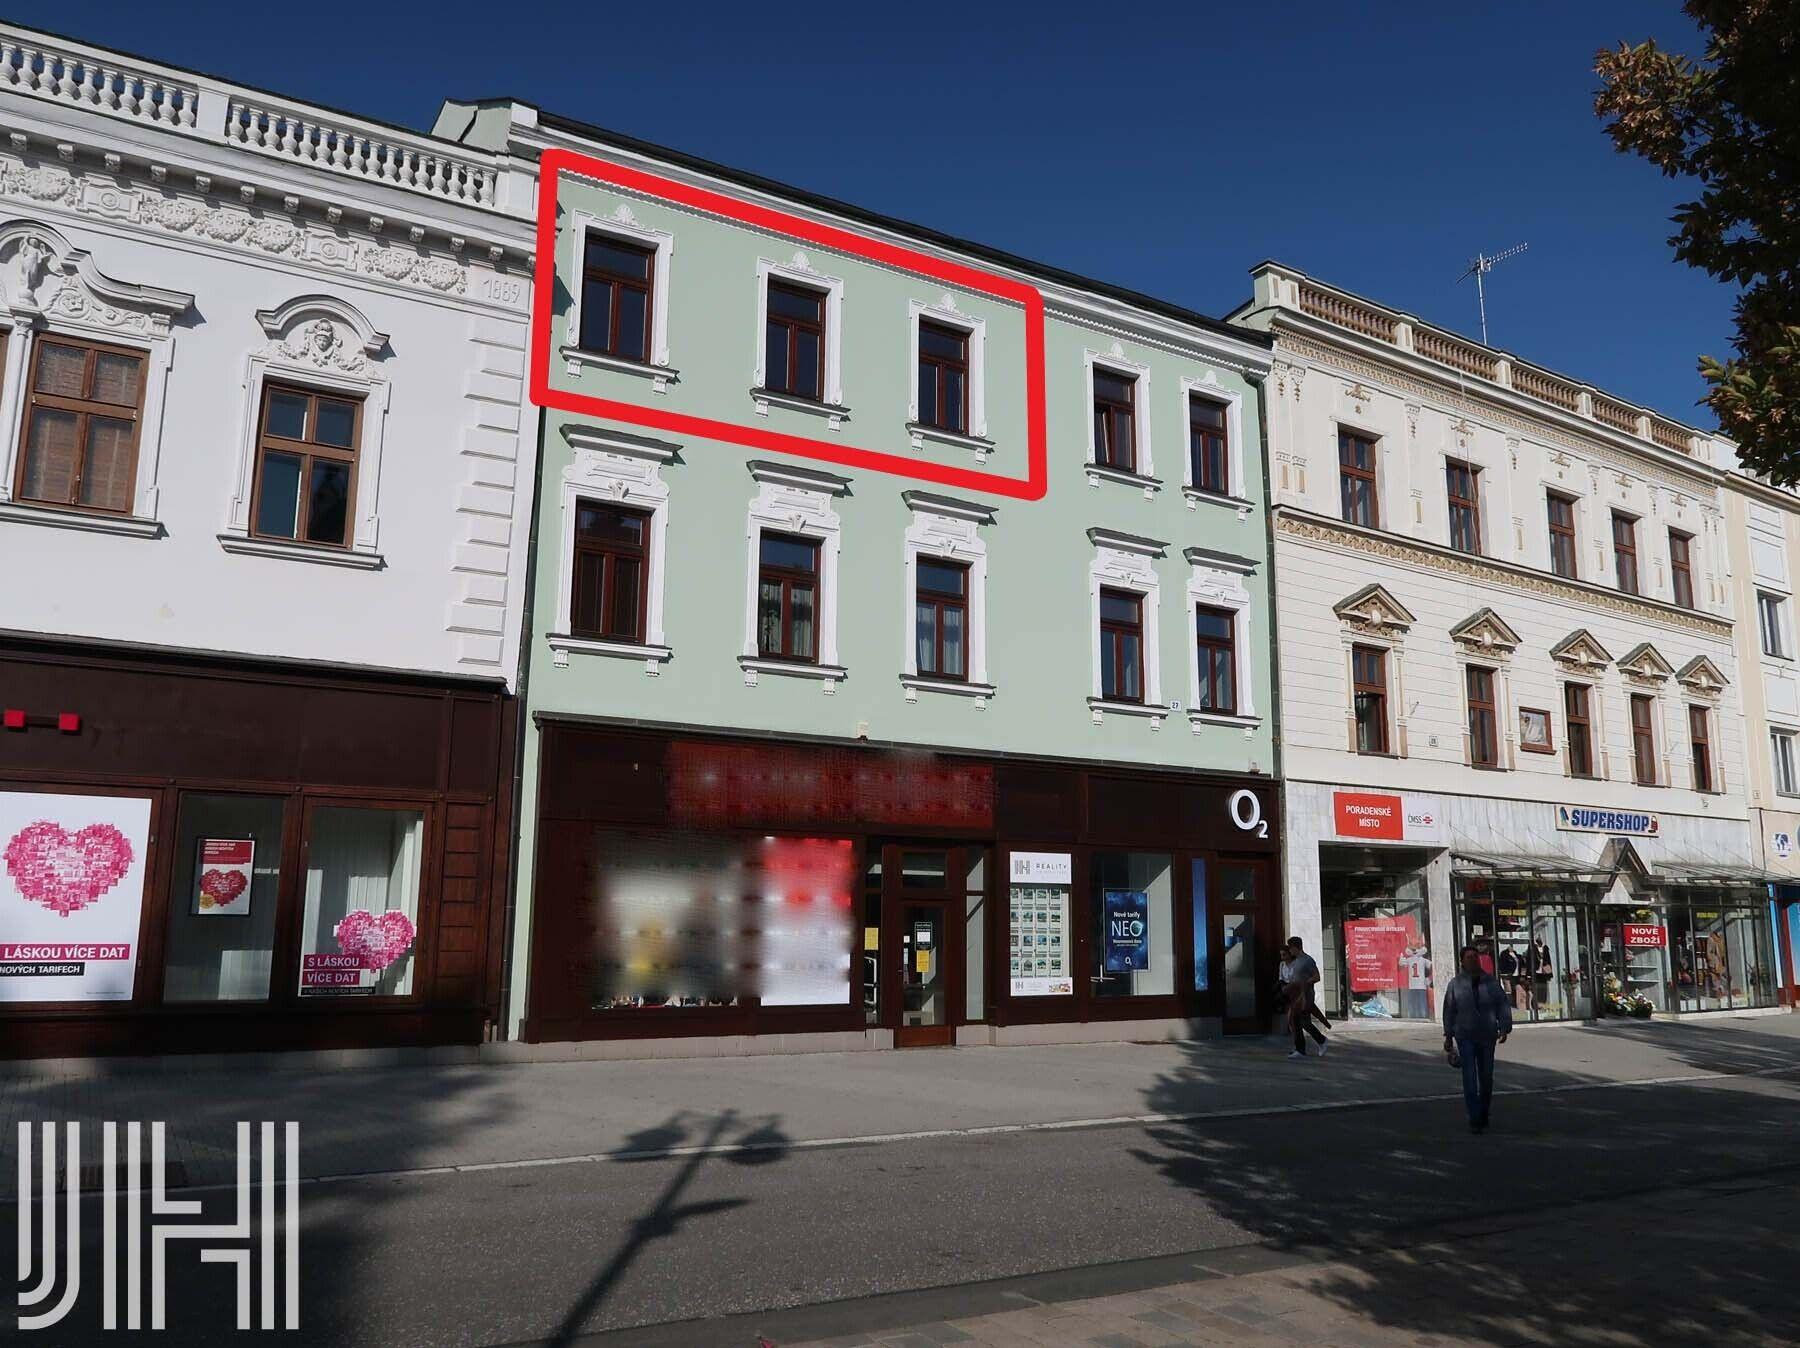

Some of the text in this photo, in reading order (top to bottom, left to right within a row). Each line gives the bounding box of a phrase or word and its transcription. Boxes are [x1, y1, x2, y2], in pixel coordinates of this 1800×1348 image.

[1171, 701, 1180, 709] 27
[1229, 789, 1269, 838] O2
[1345, 805, 1392, 817] PORADENSKÉ
[1359, 817, 1380, 828] MÍSTO
[1571, 809, 1650, 832] SUPERSHOP
[1111, 920, 1144, 937] NEO
[4, 944, 126, 959] LÁSKOU VÍCE DAT
[308, 955, 360, 967] S LÁSKOU
[0, 963, 81, 974] NOVÝCH TARIFECH
[307, 972, 356, 983] VÍCE DAT
